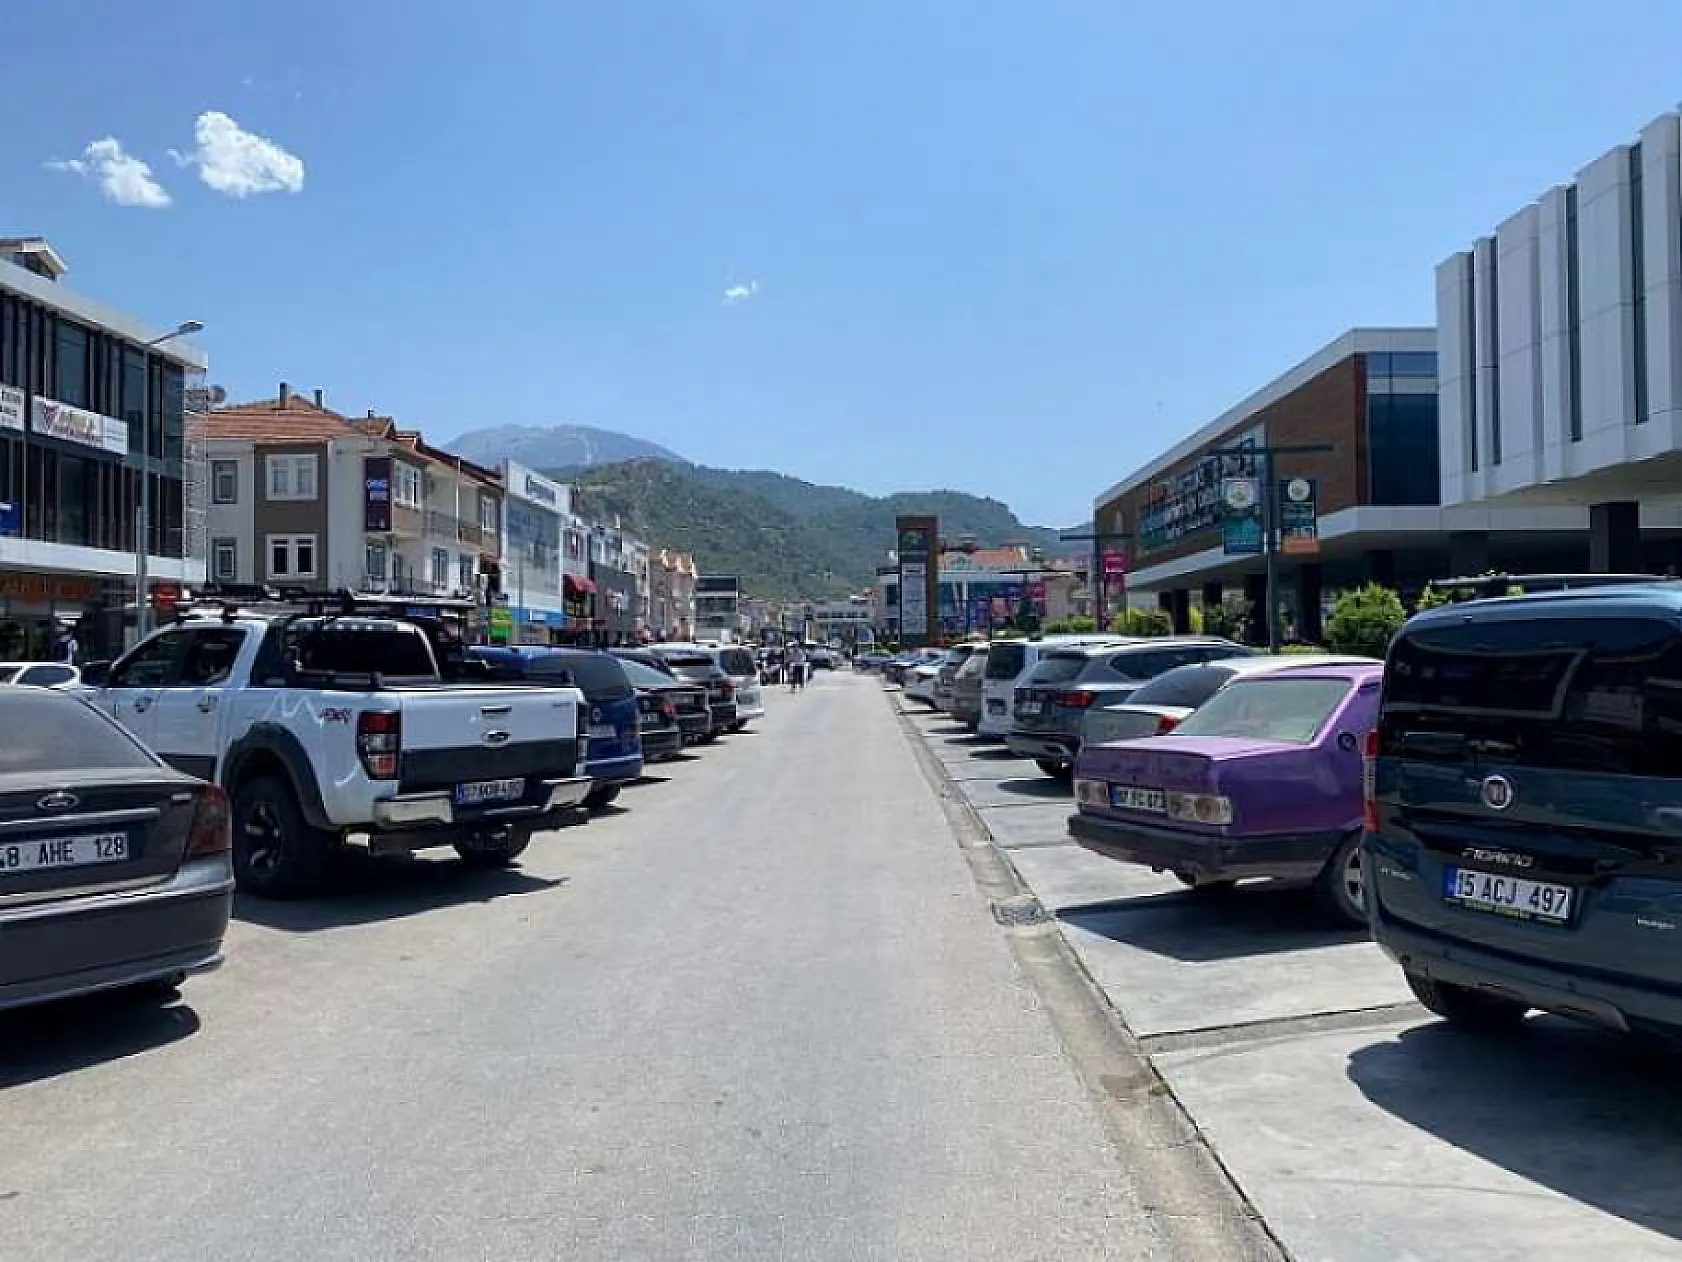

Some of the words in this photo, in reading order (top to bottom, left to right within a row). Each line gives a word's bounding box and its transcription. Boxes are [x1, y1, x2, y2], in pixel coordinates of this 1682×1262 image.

[39, 841, 74, 866] AHE
[94, 836, 125, 858] 128
[1458, 871, 1475, 897] 15
[1482, 877, 1517, 903] ACJ
[1529, 886, 1568, 913] 497
